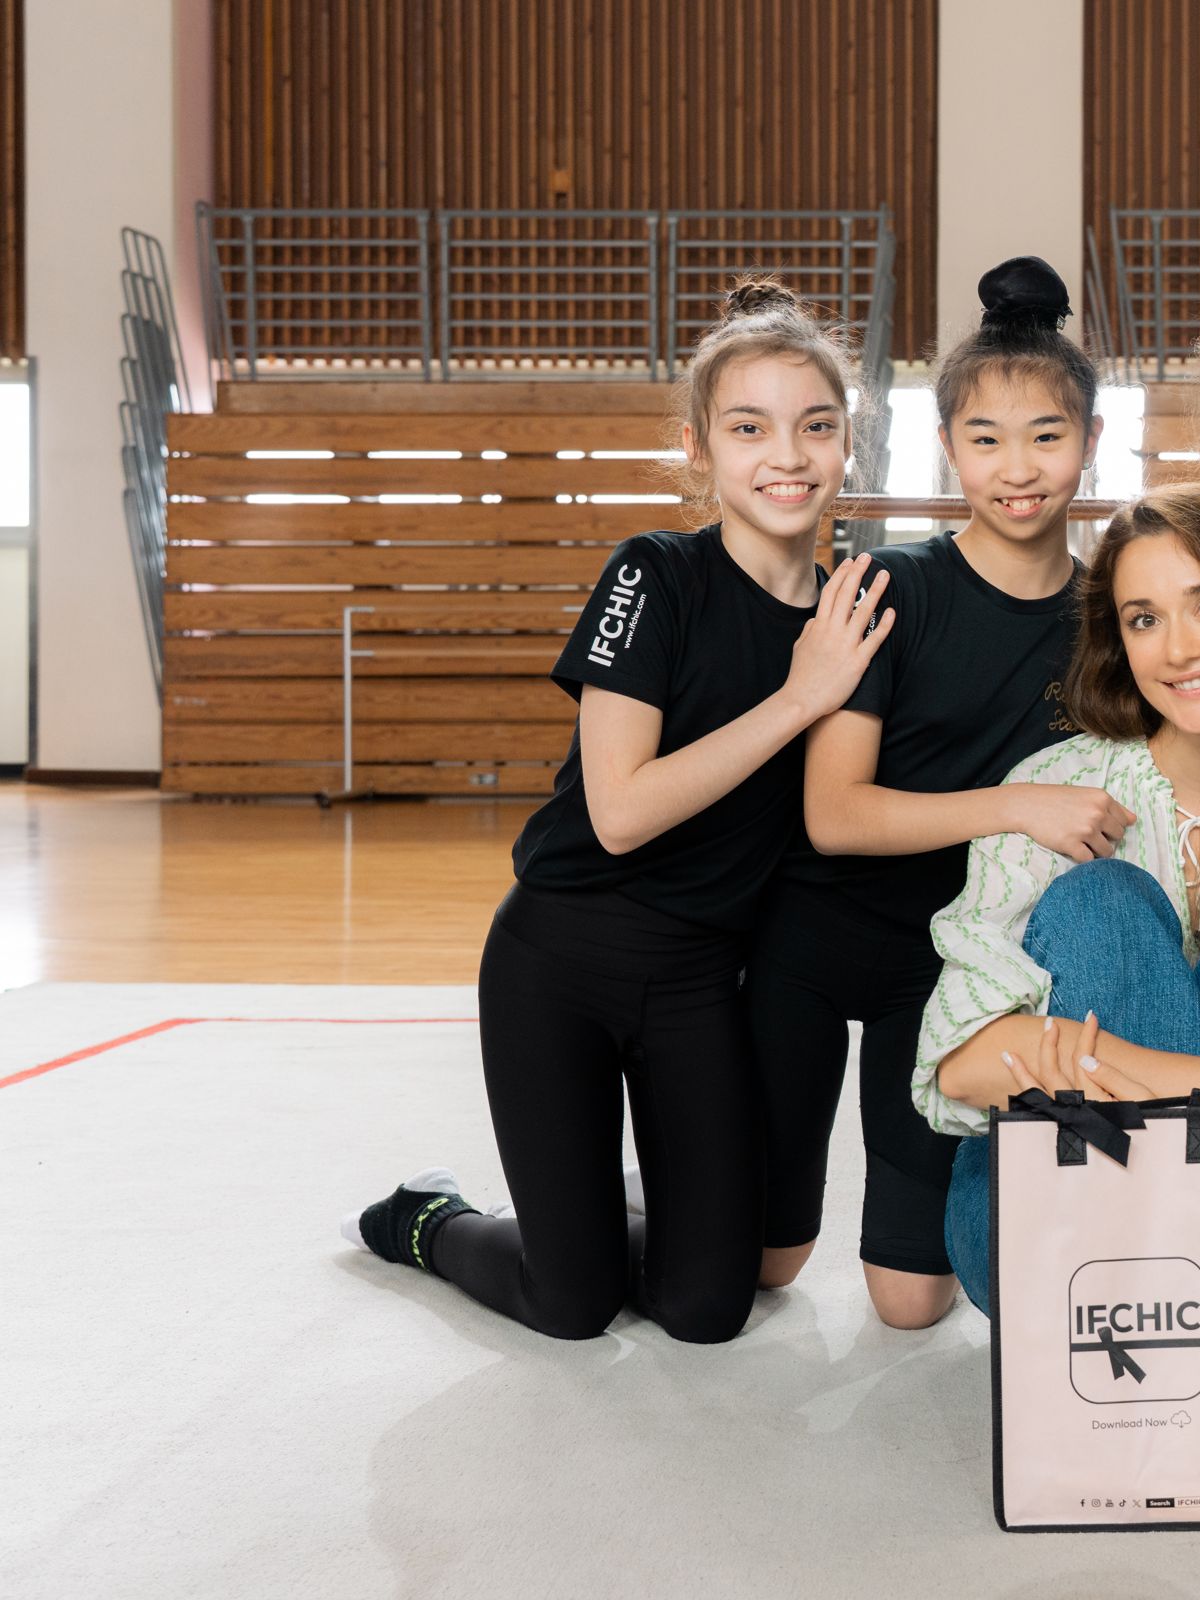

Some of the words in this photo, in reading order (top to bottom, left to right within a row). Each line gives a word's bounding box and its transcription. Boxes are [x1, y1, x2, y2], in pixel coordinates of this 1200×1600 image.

[587, 564, 642, 668] IFCHIC
[624, 593, 647, 649] www.ifchic.com
[1076, 1301, 1200, 1335] IFCHIC
[1091, 1418, 1143, 1430] Download
[1145, 1418, 1168, 1427] Now
[1149, 1500, 1172, 1508] Search
